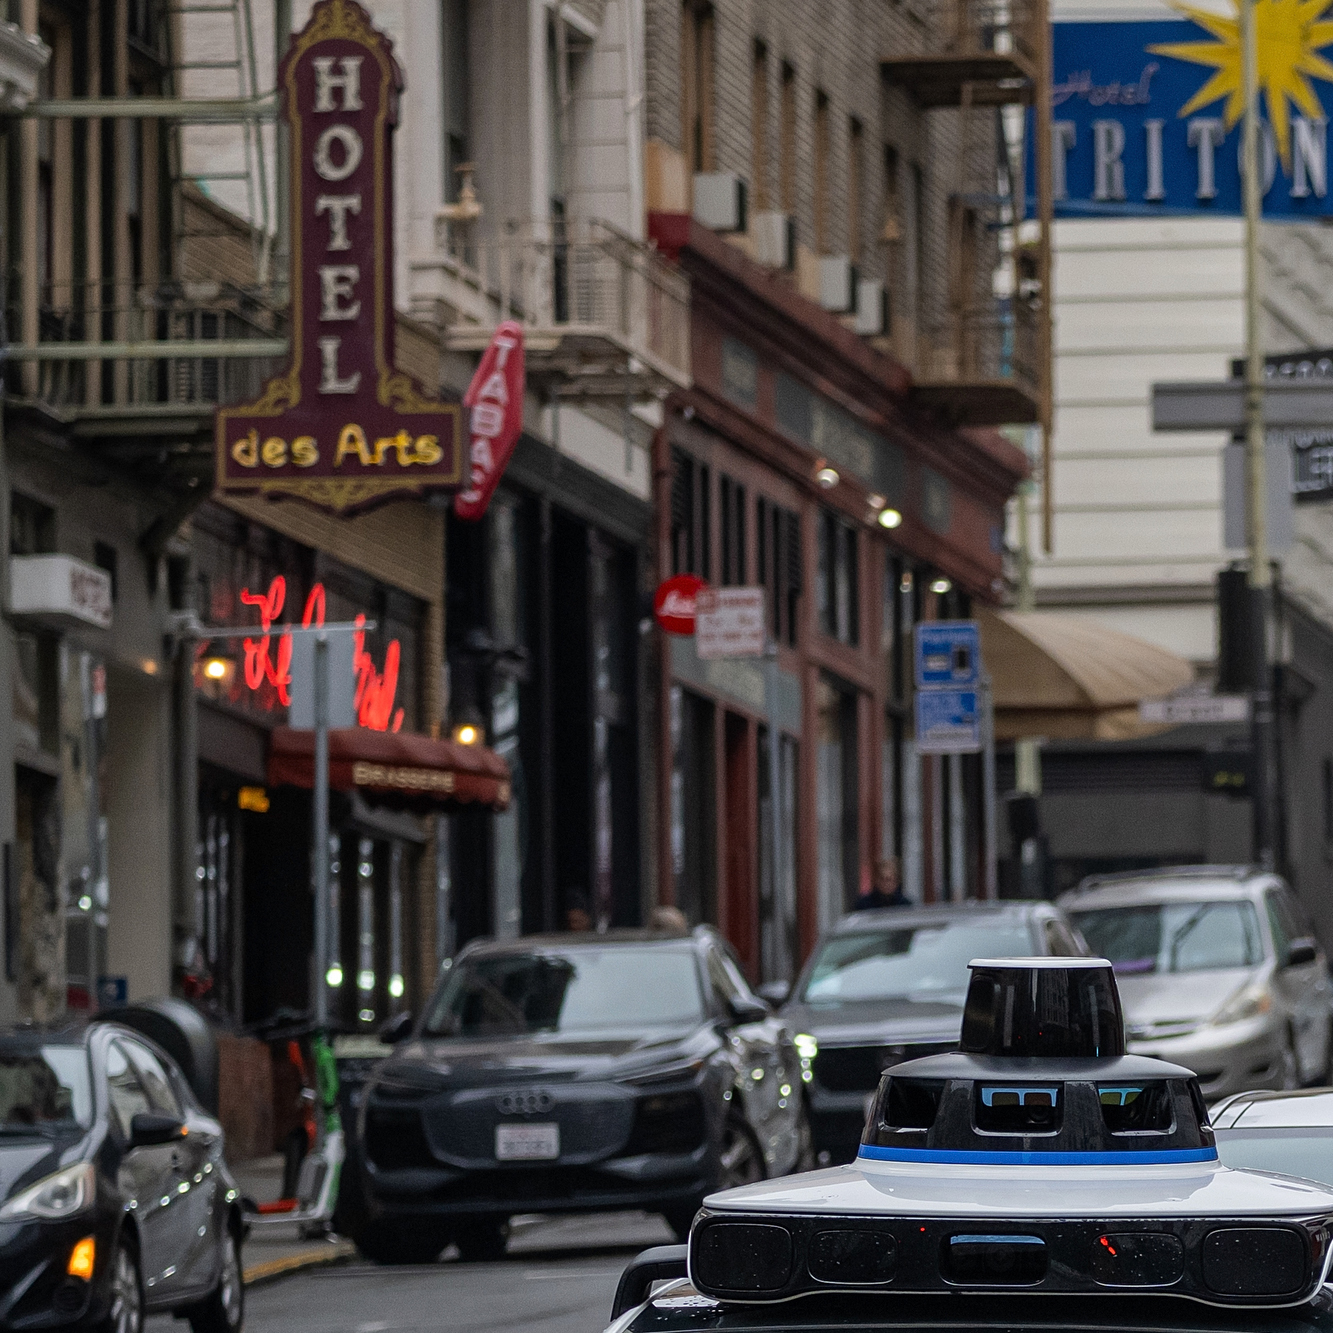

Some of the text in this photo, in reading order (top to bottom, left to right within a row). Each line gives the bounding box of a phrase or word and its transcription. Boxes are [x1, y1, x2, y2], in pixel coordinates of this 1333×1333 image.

[1052, 117, 1329, 200] TRITON
[312, 56, 363, 394] HOTEL
[231, 423, 443, 468] des Arts
